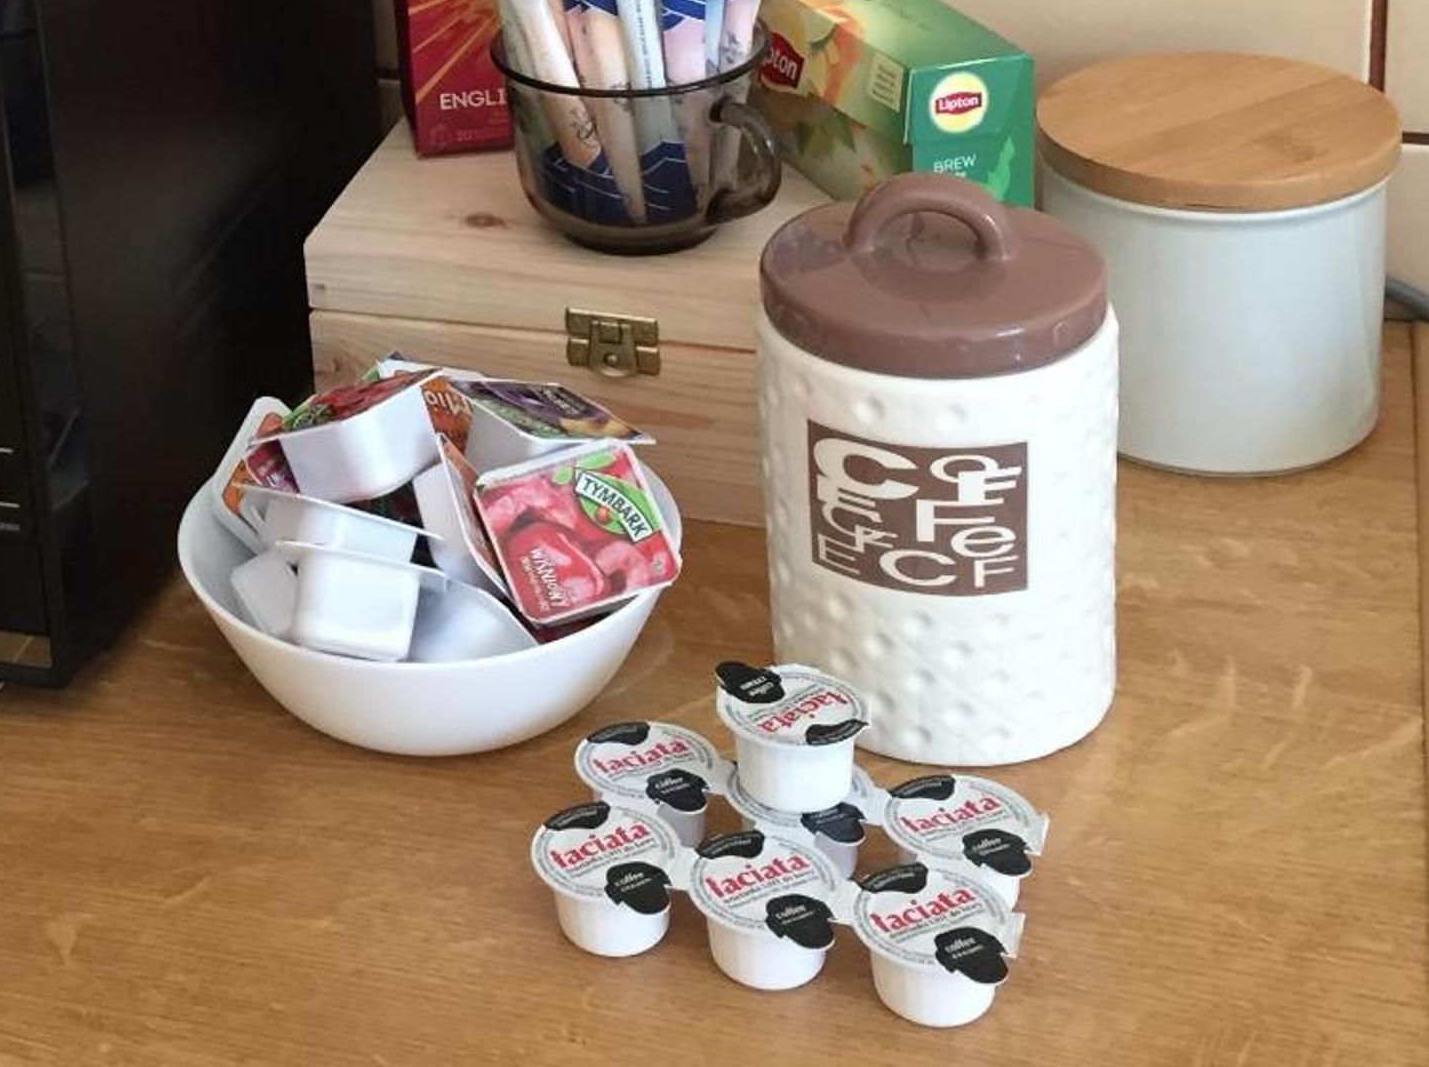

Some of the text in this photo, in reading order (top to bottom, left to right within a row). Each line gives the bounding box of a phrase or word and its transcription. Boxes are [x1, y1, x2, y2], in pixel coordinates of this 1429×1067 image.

[763, 47, 798, 81] pton
[439, 88, 507, 110] ENGLI
[938, 95, 979, 112] Lipton
[933, 153, 977, 173] BREW
[582, 477, 649, 538] TYMBARK
